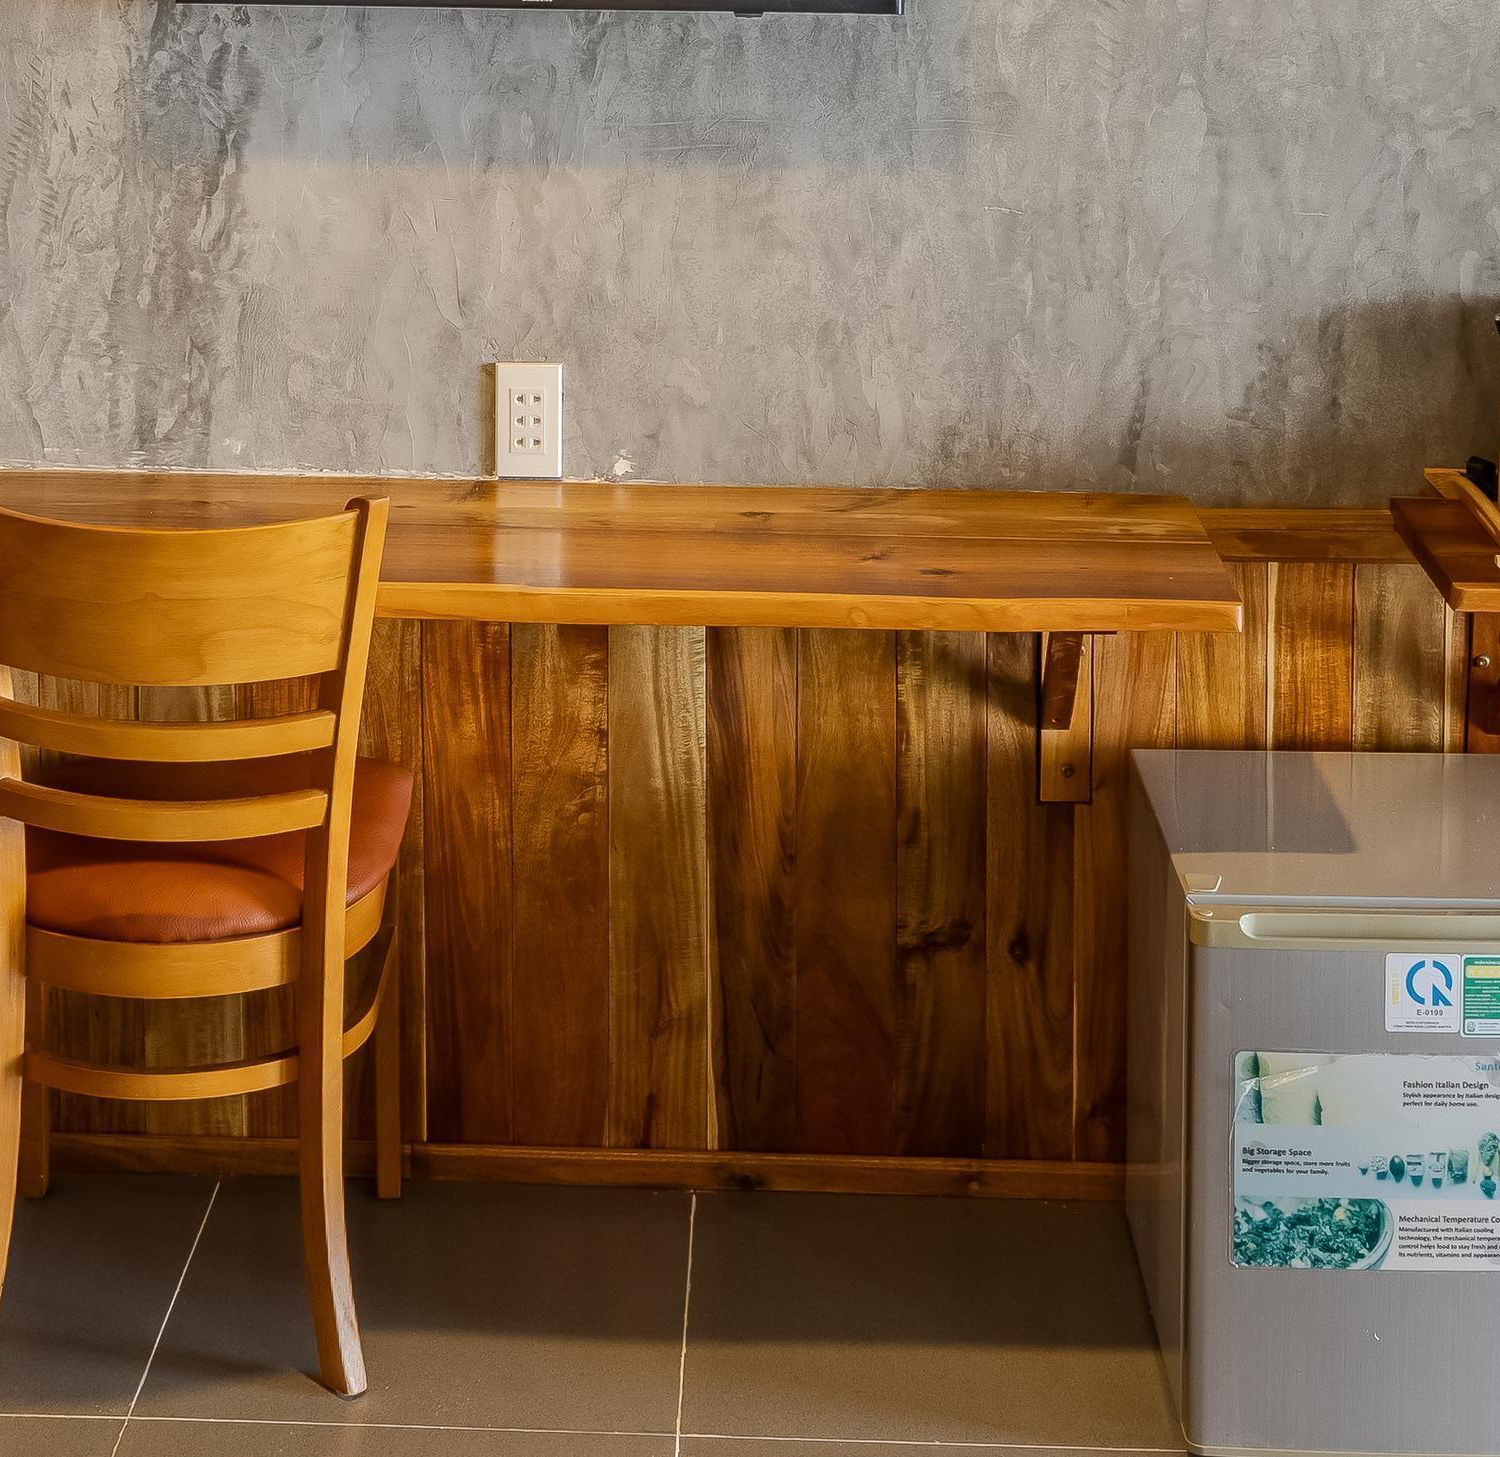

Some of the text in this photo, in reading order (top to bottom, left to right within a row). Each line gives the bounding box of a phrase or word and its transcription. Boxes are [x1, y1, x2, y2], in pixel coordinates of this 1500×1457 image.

[1402, 1080, 1489, 1090] Fashion Italian Design
[1242, 1147, 1312, 1157] Big Storage Space
[1443, 1216, 1489, 1224] Temperature
